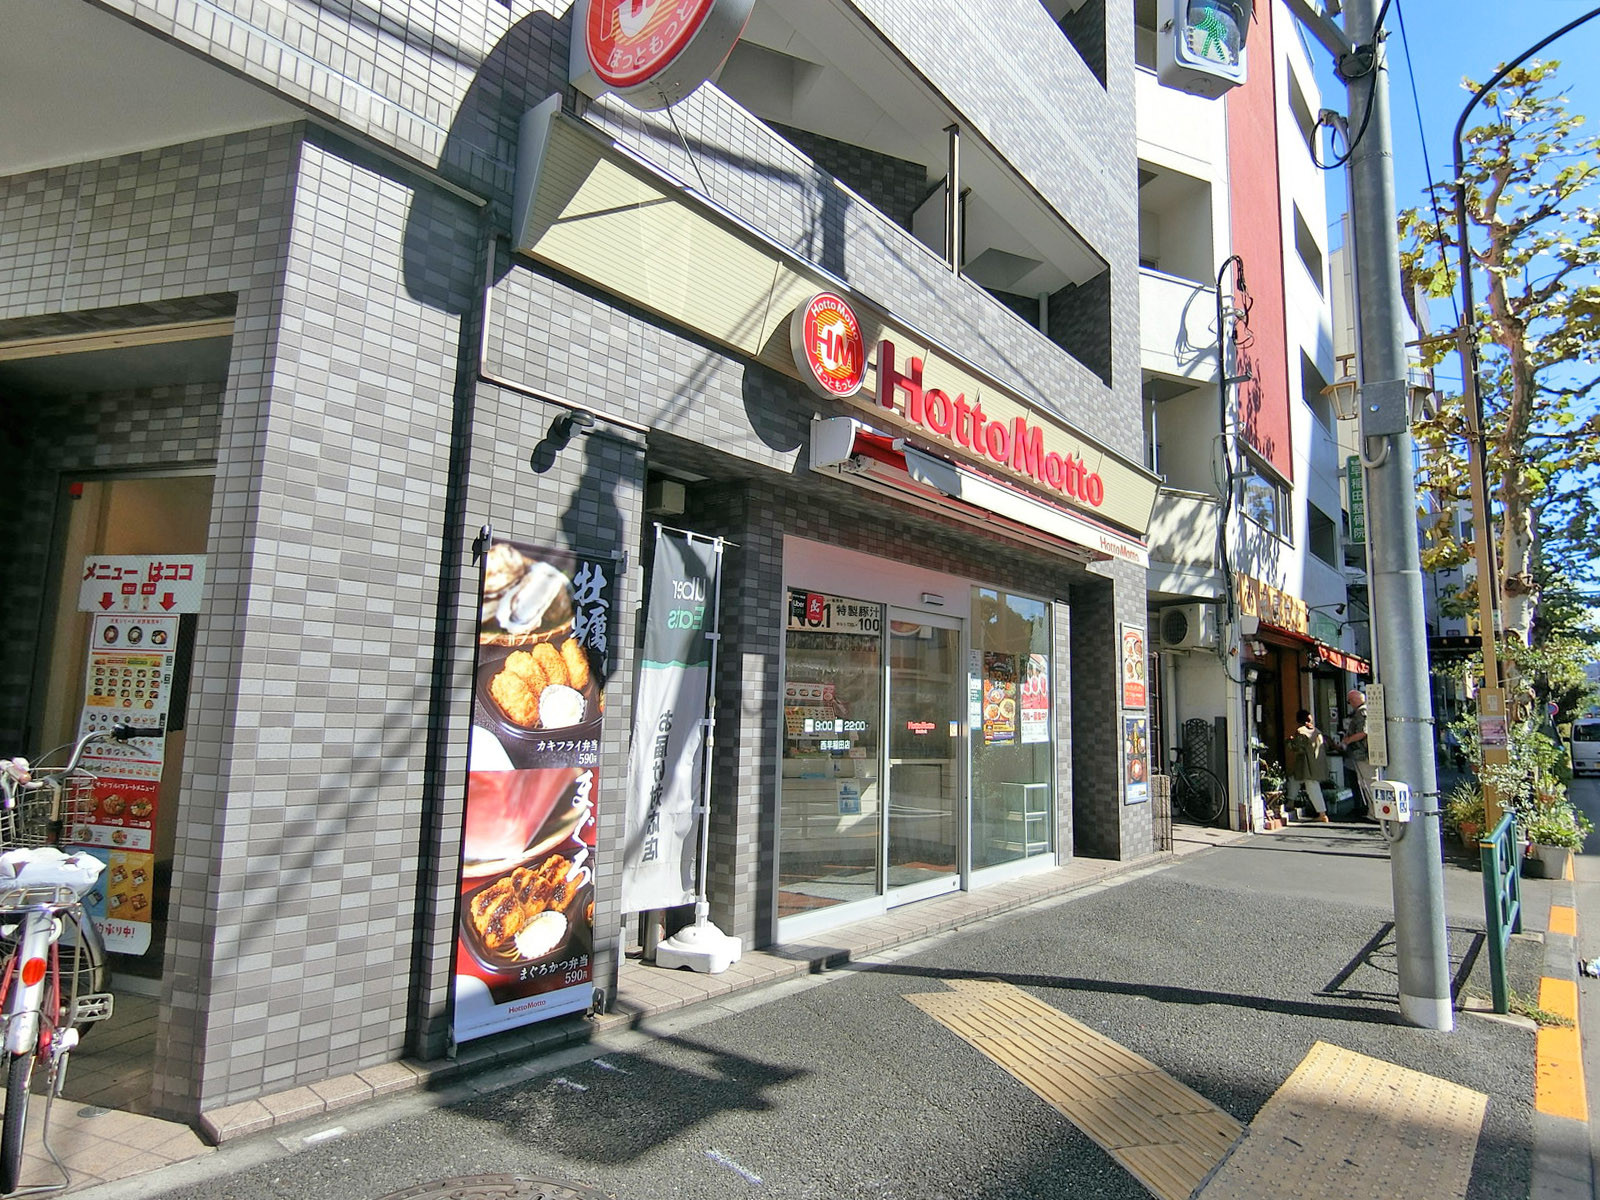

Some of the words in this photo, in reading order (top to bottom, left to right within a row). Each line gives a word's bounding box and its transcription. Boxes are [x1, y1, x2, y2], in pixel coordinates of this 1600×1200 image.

[606, 1, 693, 69] ほっともっと
[811, 300, 837, 317] Hotto
[836, 304, 859, 340] Motto
[815, 363, 854, 390] ほっともっと
[876, 339, 1104, 507] HottoMotto
[1099, 535, 1140, 562] HottoMotto
[83, 562, 139, 581] メニュー
[147, 561, 194, 582] はココ
[570, 561, 609, 653] 牡蠣
[836, 604, 880, 618] 特製豚汁
[858, 618, 880, 632] 100
[815, 720, 833, 731] 9:00
[844, 720, 866, 731] 22:00
[537, 740, 598, 752] カキフライ弁当
[565, 769, 595, 891] まぐろ
[519, 954, 589, 981] まぐろかつ弁当
[508, 999, 547, 1014] HottoMotto
